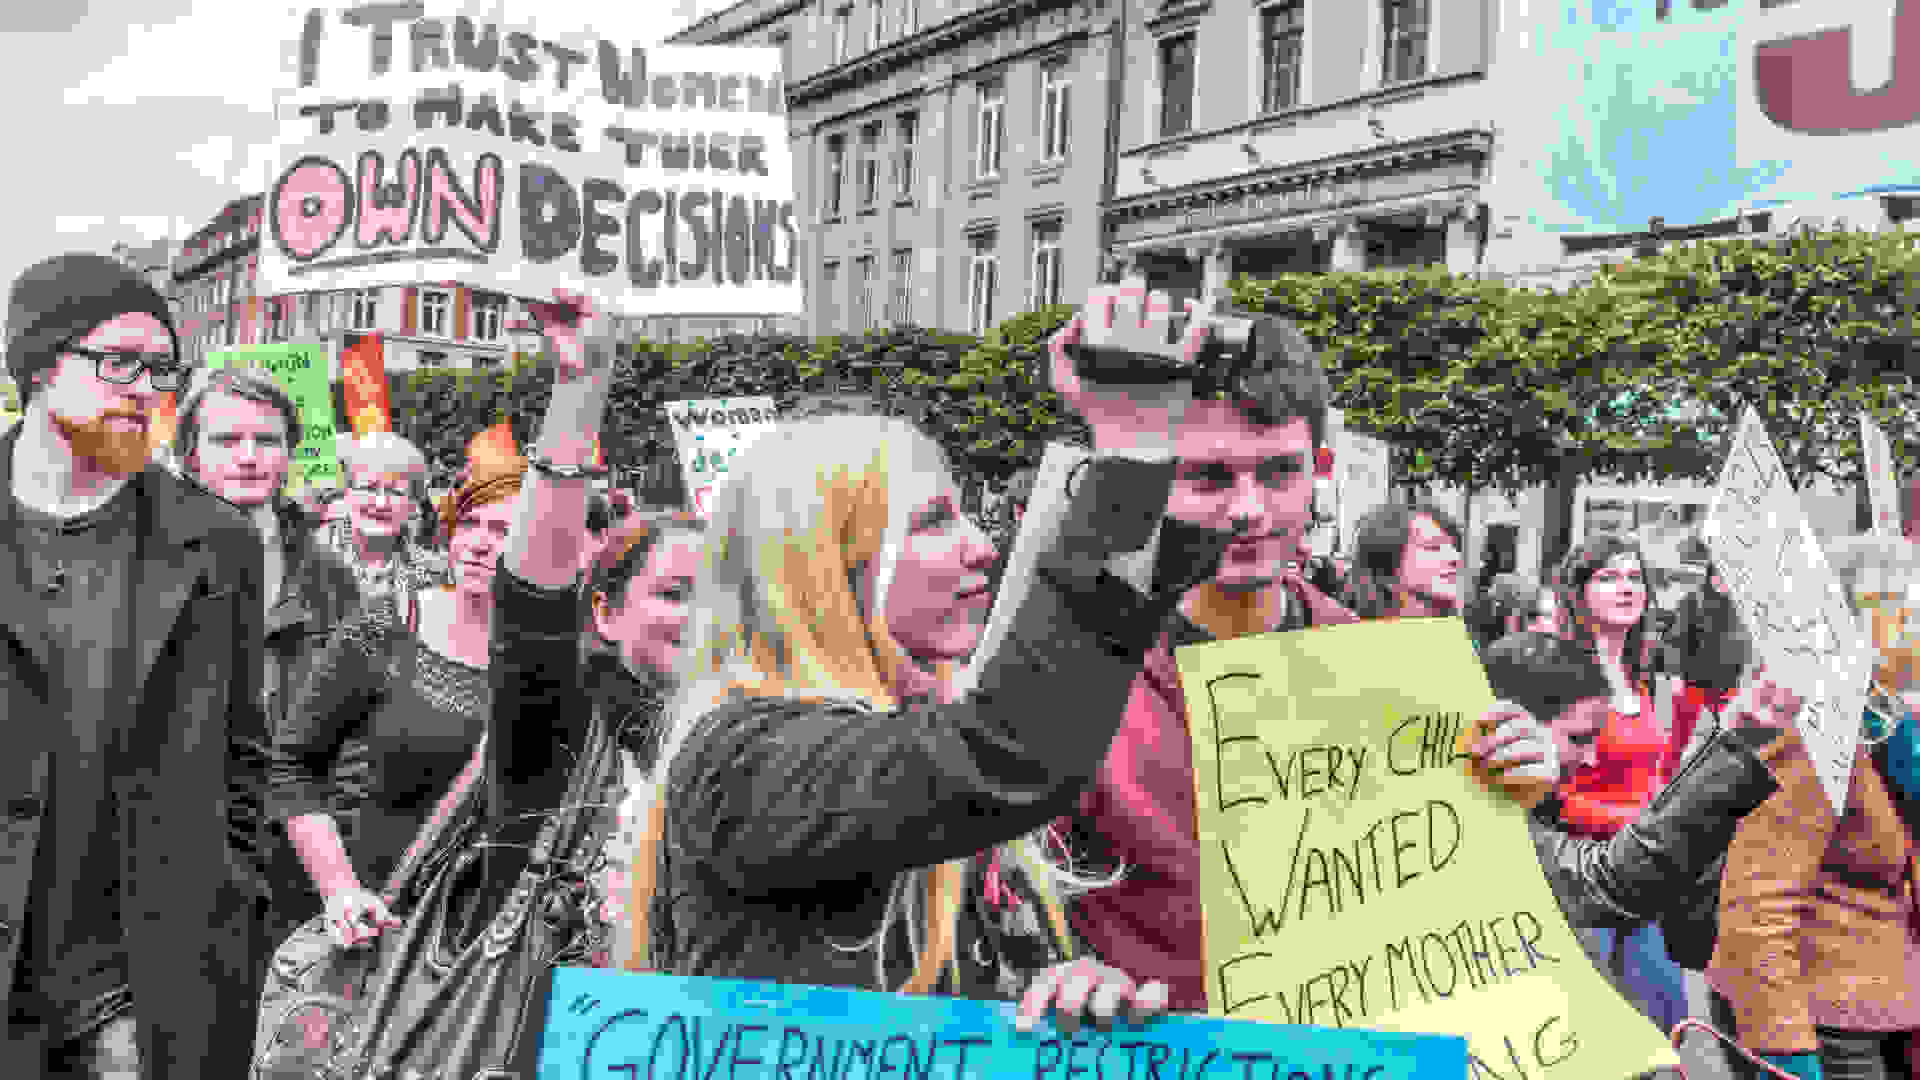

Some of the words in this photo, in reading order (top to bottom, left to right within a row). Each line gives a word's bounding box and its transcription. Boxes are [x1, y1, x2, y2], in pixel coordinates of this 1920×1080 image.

[299, 99, 390, 135] TO
[413, 82, 582, 152] MAKE
[302, 8, 323, 87] I
[341, 0, 590, 90] TRUST
[598, 38, 785, 112] WOMEN
[271, 147, 504, 261] OWN
[518, 162, 798, 288] DECISIONS
[1206, 671, 1367, 813] EVERY
[1386, 711, 1474, 776] CHIL
[1221, 799, 1462, 938] WANTED
[1217, 951, 1372, 1028] EVERY
[1385, 911, 1561, 1012] MOTHER
